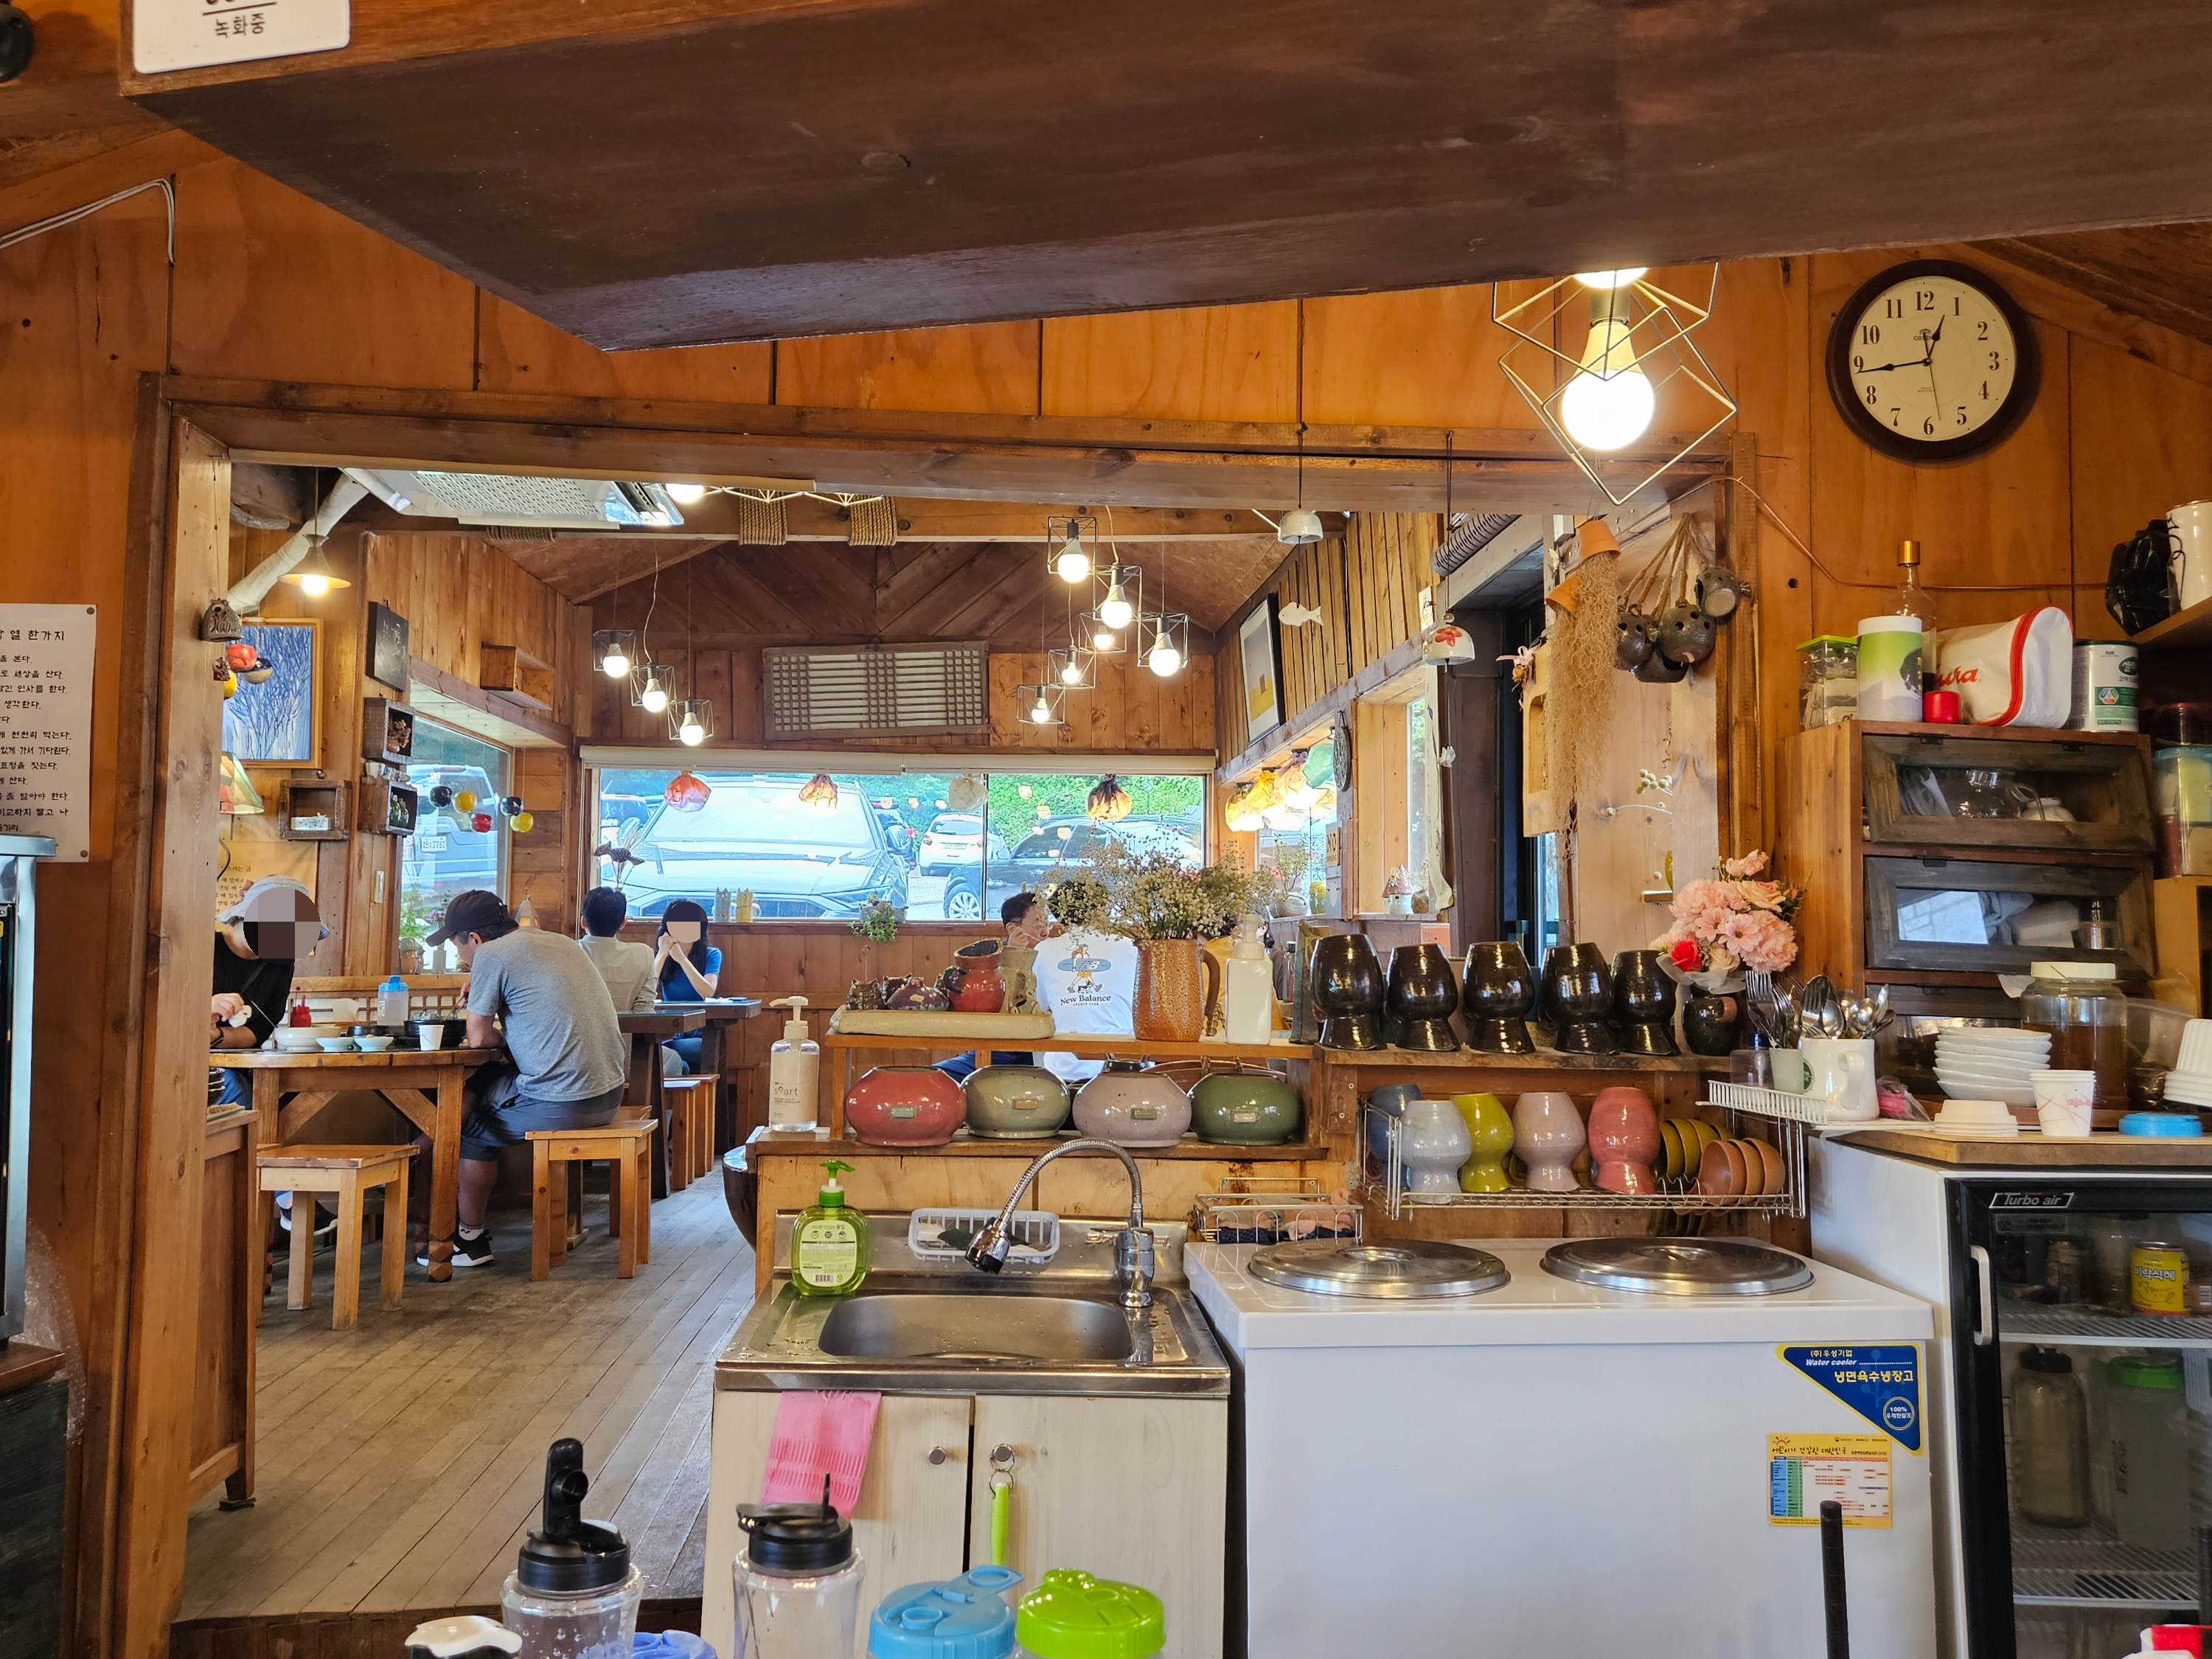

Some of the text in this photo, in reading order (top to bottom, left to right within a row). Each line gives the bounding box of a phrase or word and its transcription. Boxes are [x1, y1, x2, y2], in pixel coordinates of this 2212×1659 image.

[215, 13, 265, 38] 녹화중
[1885, 299, 1904, 319] 11
[1916, 291, 1935, 310] 12
[1953, 296, 1961, 316] 1
[1861, 324, 1880, 344] 10
[1977, 321, 1988, 341] 2
[1853, 355, 1864, 375] 9
[1989, 351, 2000, 371] 3
[1866, 385, 1877, 405] 8
[1978, 380, 1989, 400] 4
[1890, 408, 1901, 427] 7
[1956, 406, 1966, 425] 5
[1923, 416, 1934, 435] 6
[10, 630, 21, 640] 열
[28, 630, 64, 641] 한가지
[14, 670, 40, 678] 세상을
[17, 685, 43, 693] 인사를
[11, 731, 38, 739] 천천히
[20, 746, 34, 755] 가서
[1, 761, 26, 770] 표정을
[20, 793, 46, 801] 알아야
[36, 808, 54, 816] 말고
[60, 808, 69, 817] 나
[1060, 997, 1077, 1006] New
[2003, 1192, 2062, 1205] Turbo air
[2135, 1267, 2176, 1281] 비락식혜
[1834, 1370, 1914, 1383] 냉면육수냉장고
